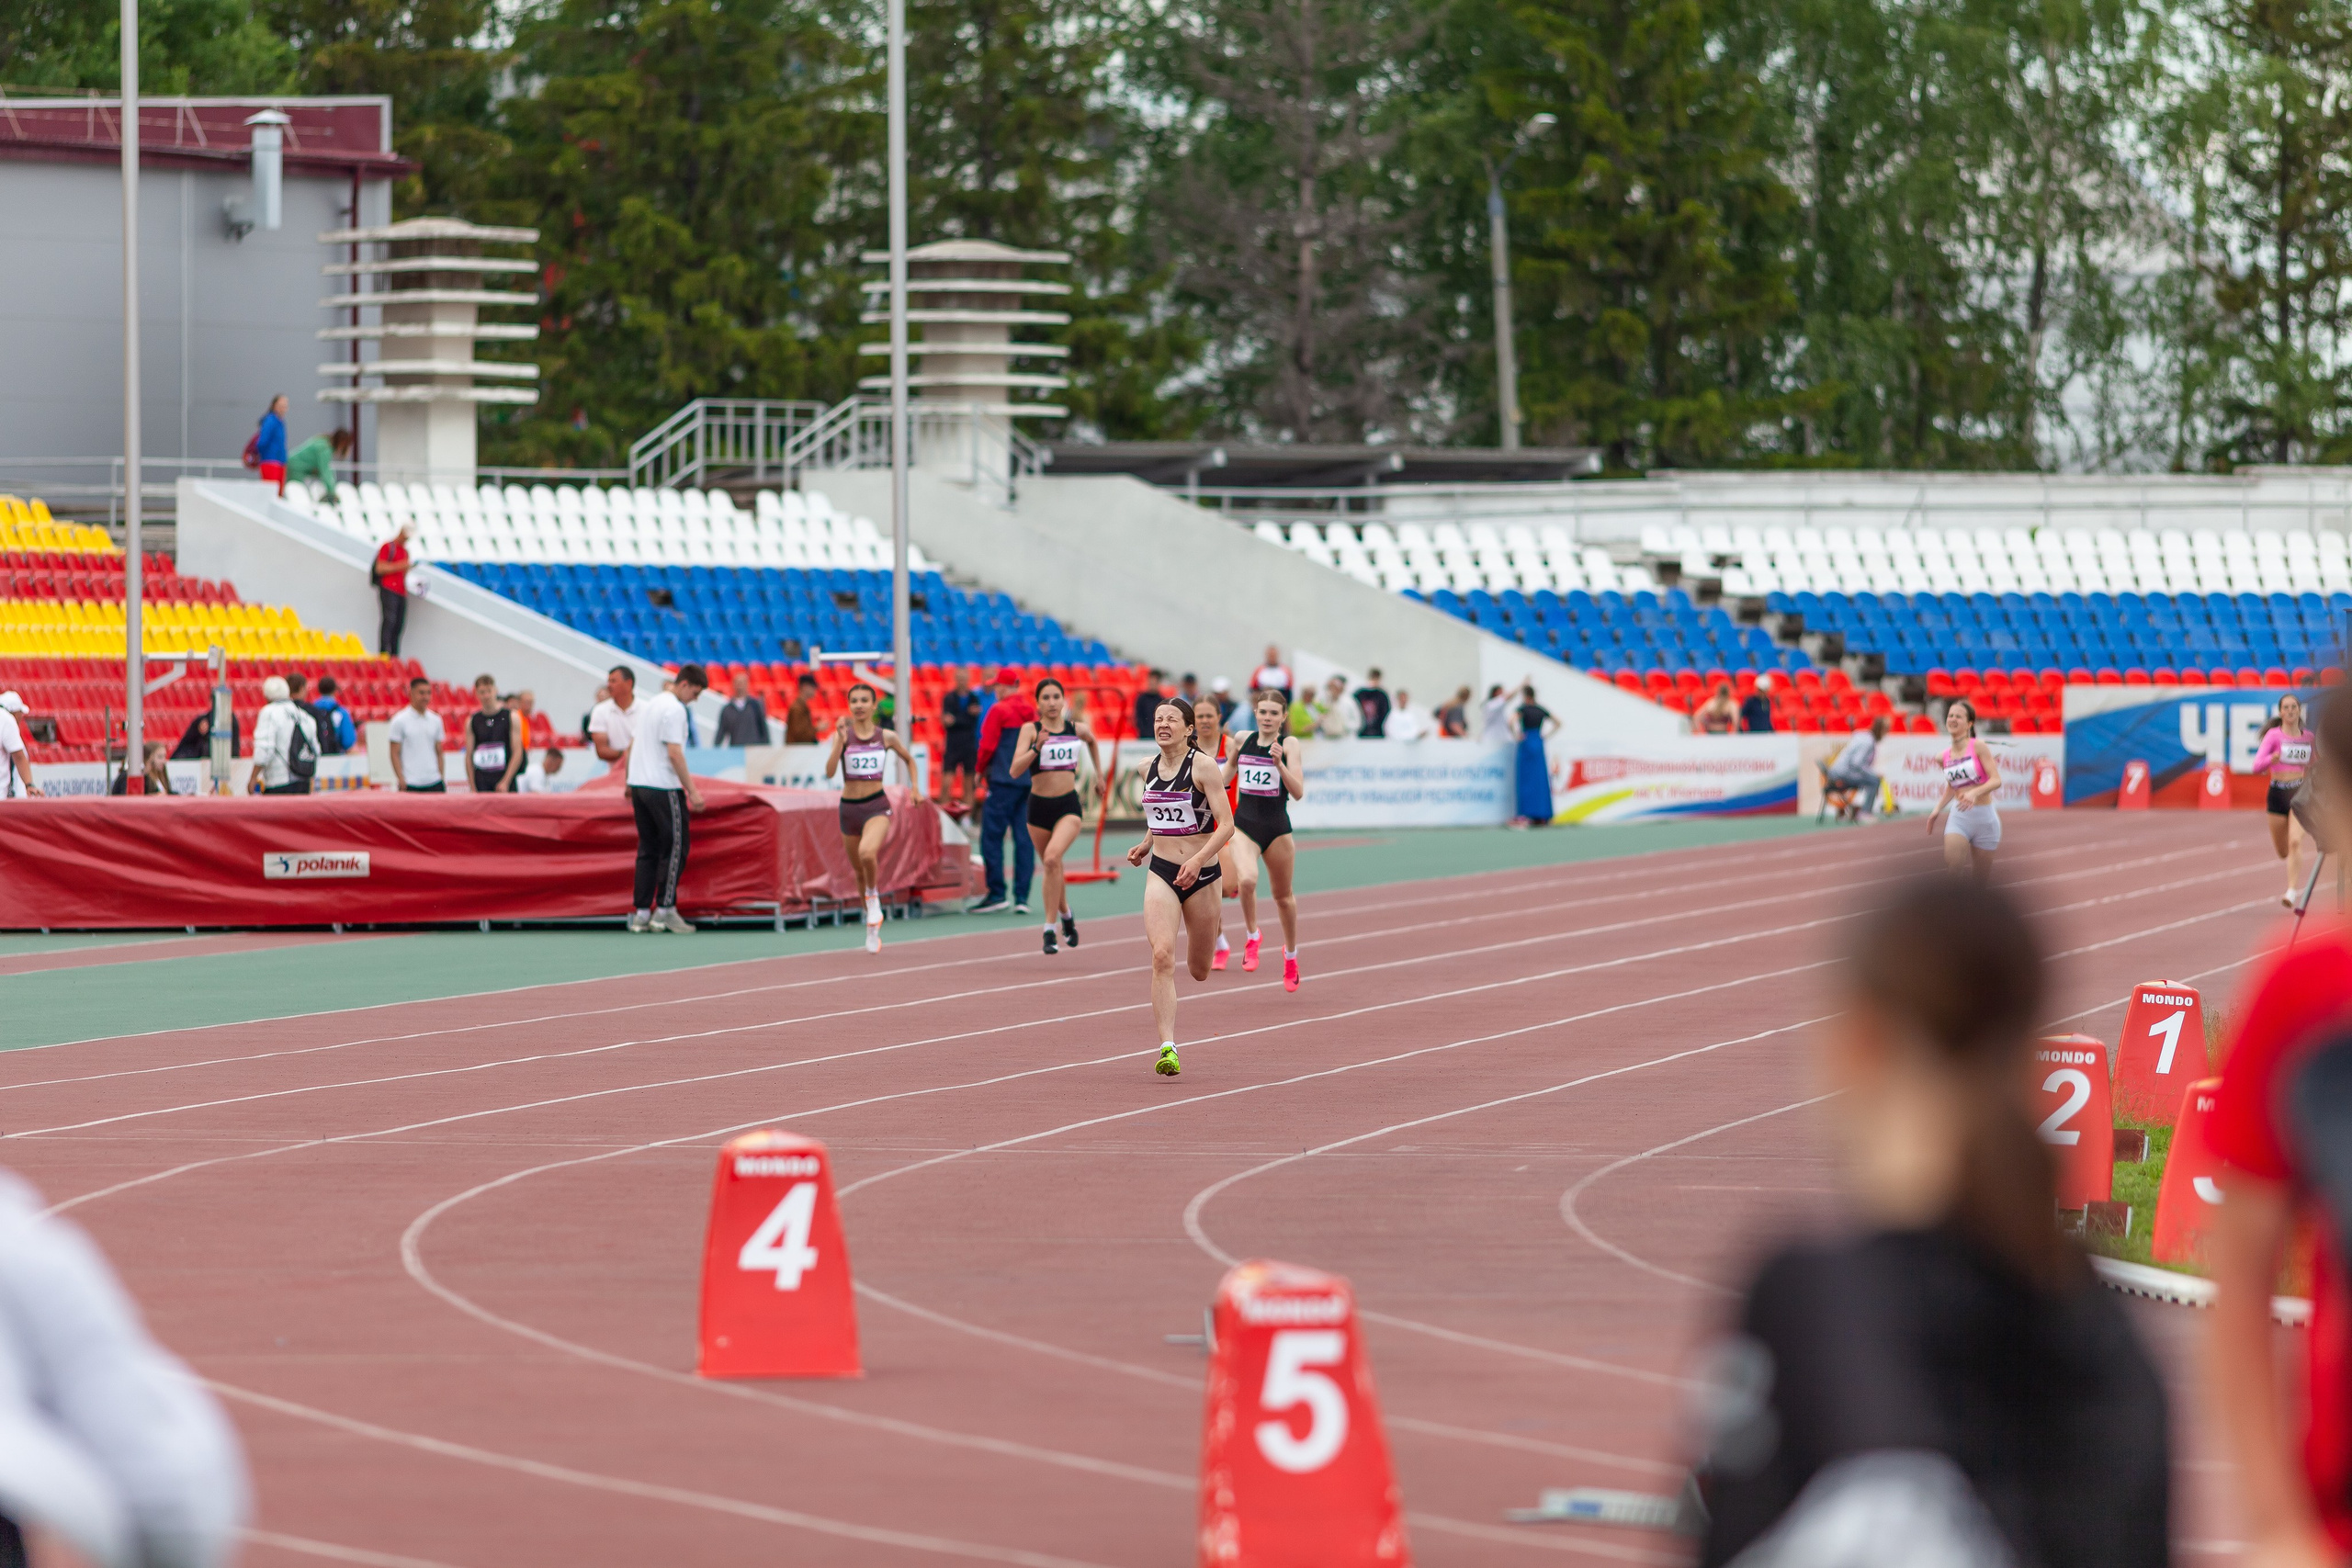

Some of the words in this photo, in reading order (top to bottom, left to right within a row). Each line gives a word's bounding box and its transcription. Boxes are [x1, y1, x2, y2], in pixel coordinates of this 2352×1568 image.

[853, 757, 878, 769] 323
[1049, 748, 1072, 760] 101
[1244, 770, 1272, 784] 142
[2126, 766, 2144, 795] 7
[2207, 768, 2224, 796] 6
[1153, 807, 1185, 822] 312
[297, 856, 359, 874] polanik
[2142, 993, 2193, 1007] MONDO
[2148, 1010, 2186, 1075] 1
[2036, 1051, 2096, 1065] MONDO
[2035, 1068, 2091, 1146] 2
[735, 1155, 820, 1177] MONDO
[738, 1181, 818, 1291] 4
[1253, 1329, 1351, 1473] 5
